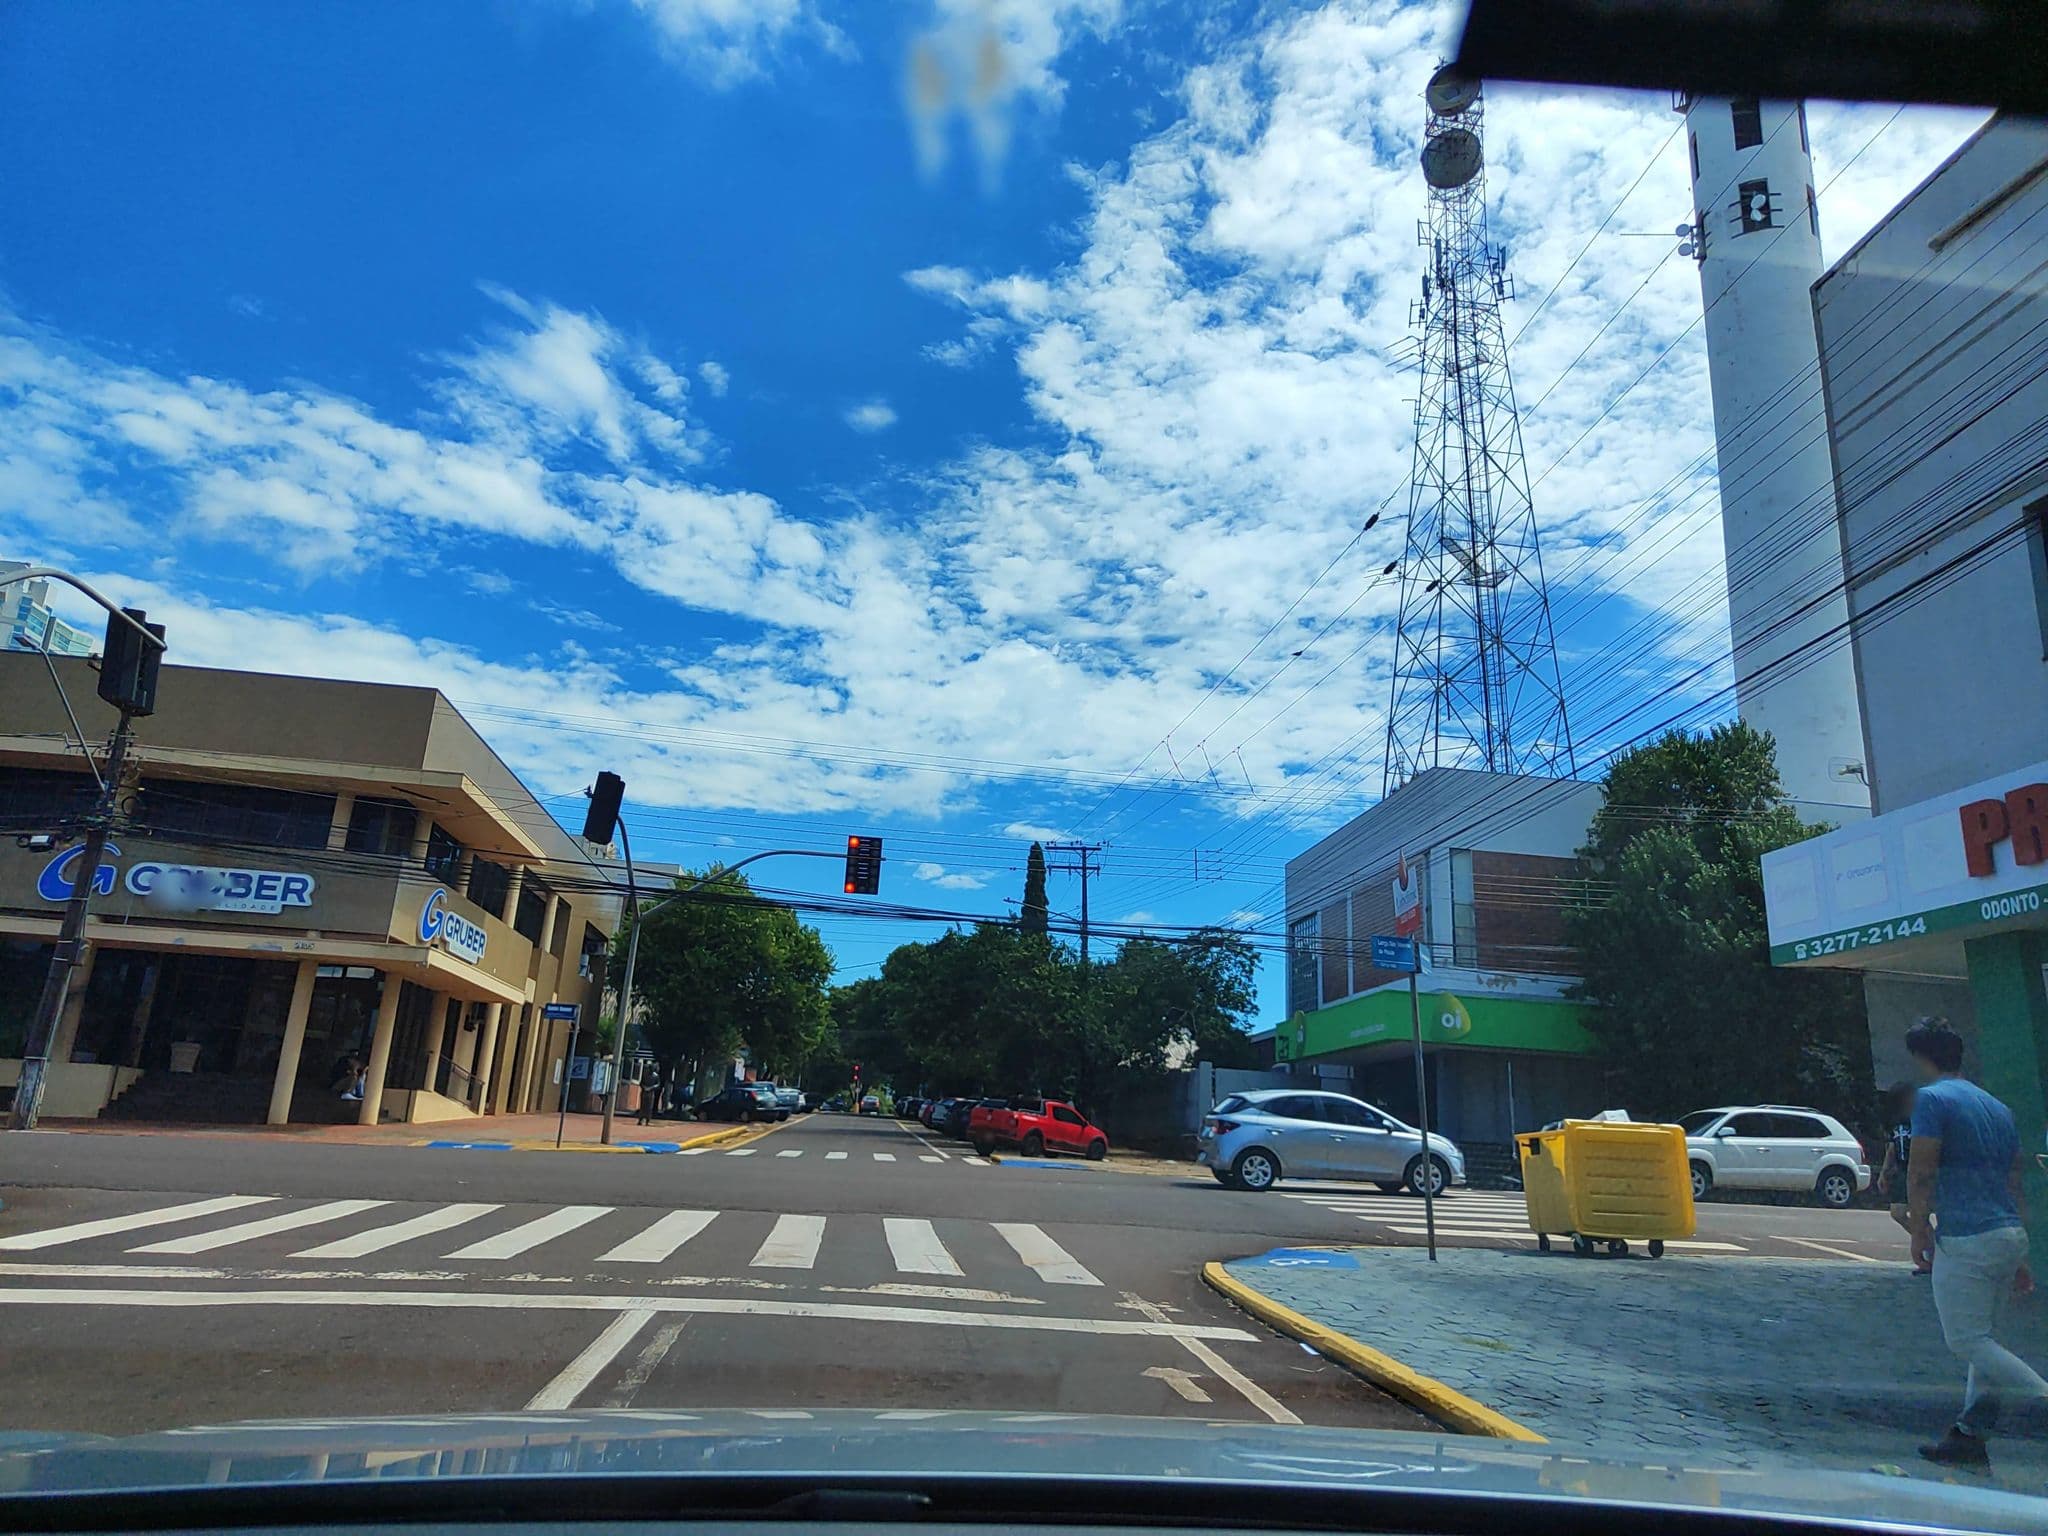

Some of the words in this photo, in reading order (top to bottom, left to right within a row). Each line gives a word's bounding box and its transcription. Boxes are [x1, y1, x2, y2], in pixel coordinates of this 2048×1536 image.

[1981, 892, 2040, 920] ODONTO
[446, 914, 486, 956] GRUBER
[1810, 917, 1927, 956] 3277-2144
[1441, 1009, 1463, 1029] oi
